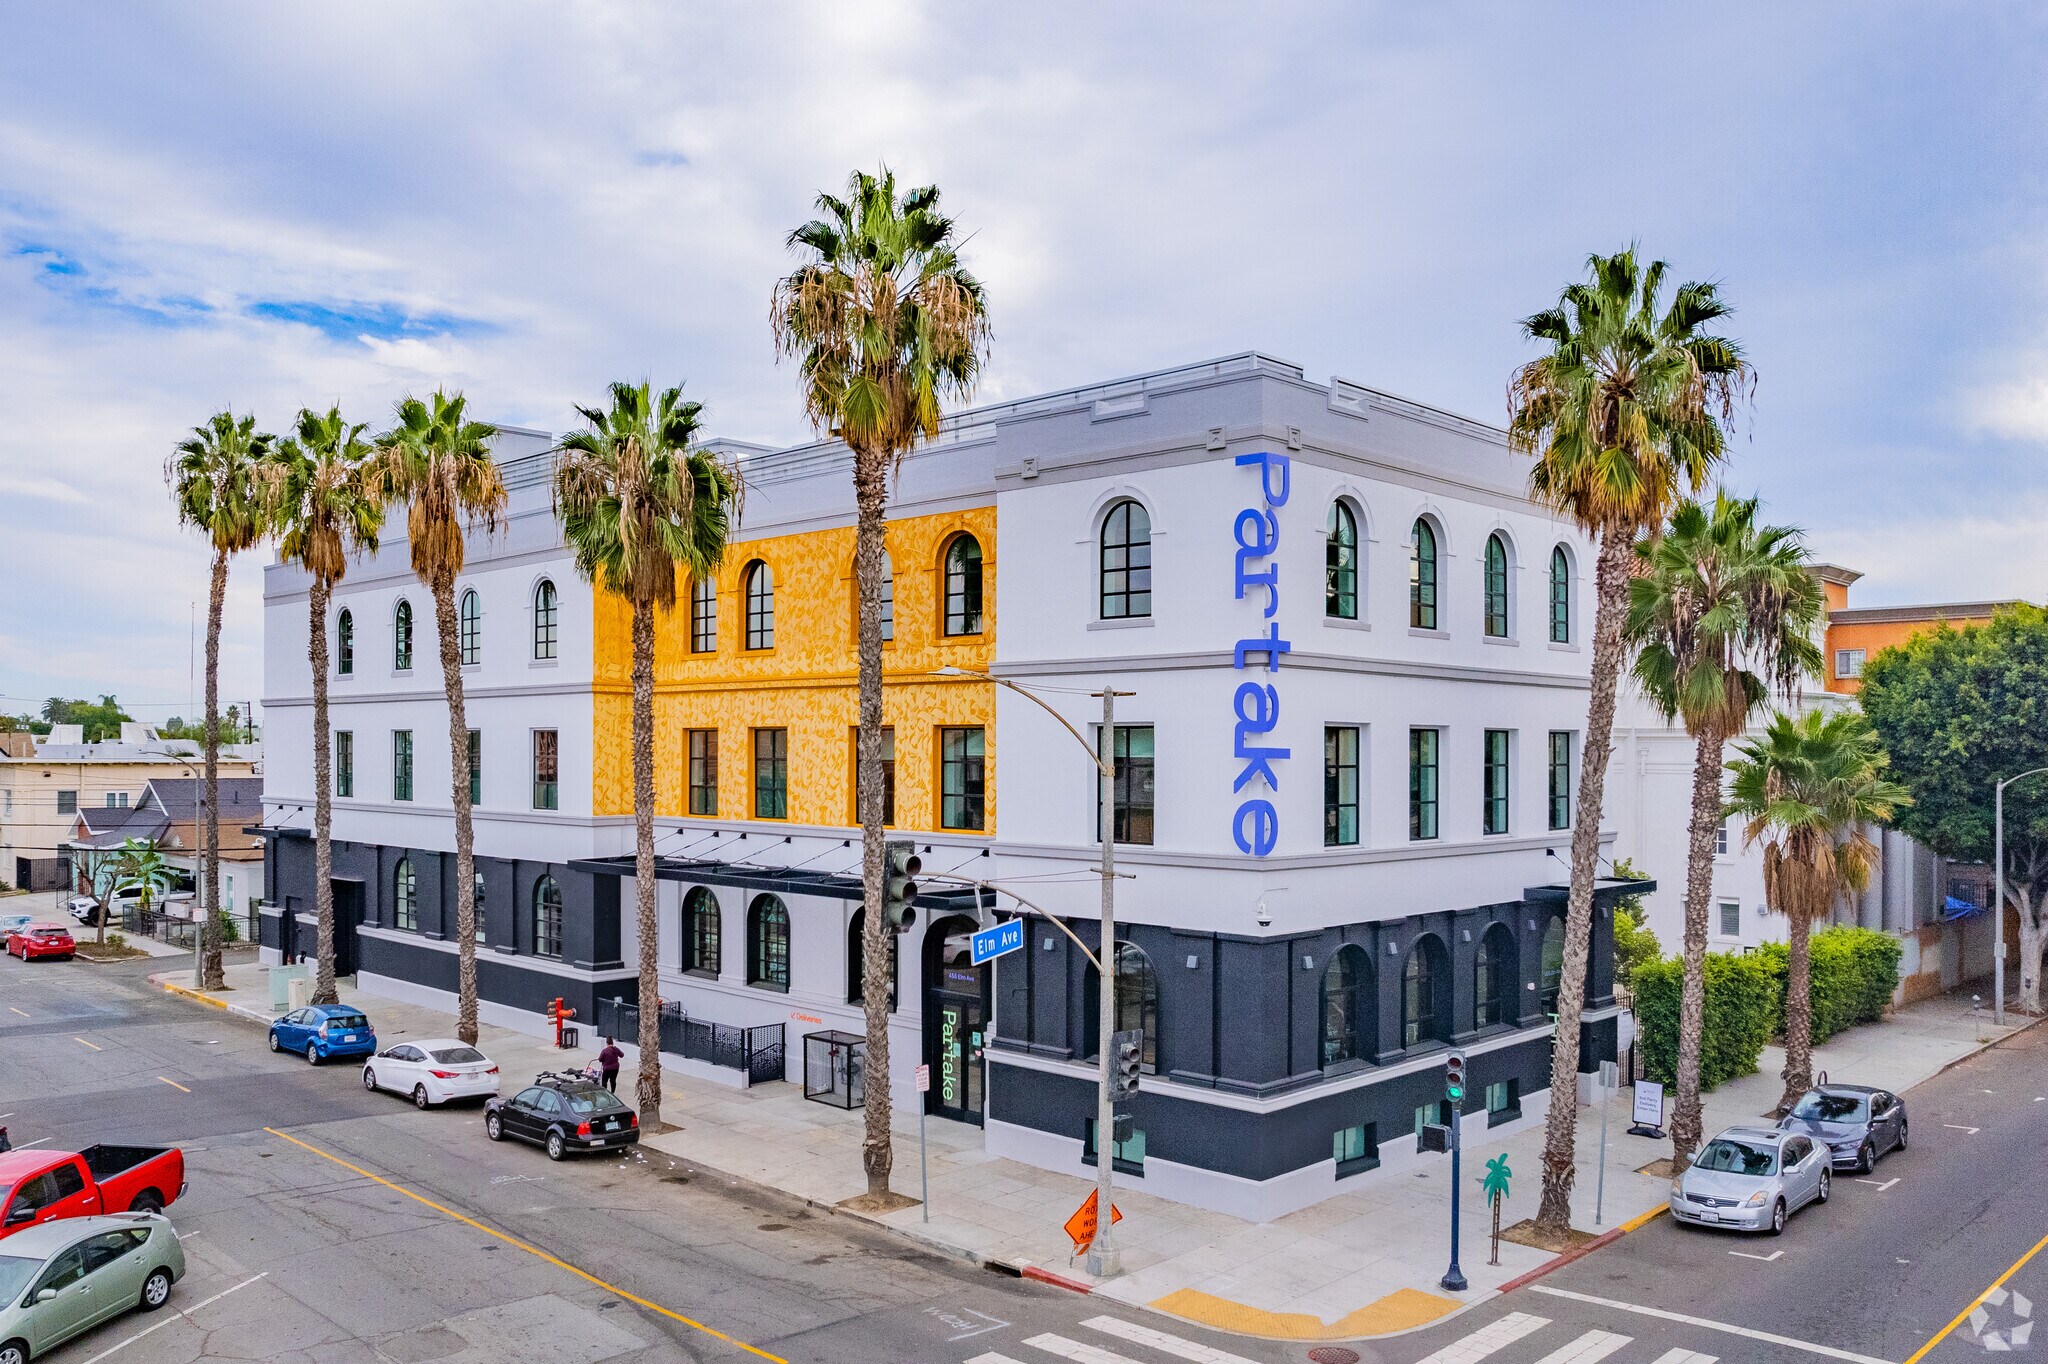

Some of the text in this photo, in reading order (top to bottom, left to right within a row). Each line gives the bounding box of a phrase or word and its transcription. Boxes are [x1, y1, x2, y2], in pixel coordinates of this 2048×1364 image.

[1233, 452, 1291, 857] Partake
[978, 930, 1018, 956] Elm Ave
[796, 1012, 822, 1025] Deliveries
[942, 1010, 957, 1101] Partake
[1084, 1205, 1098, 1216] RO
[1079, 1229, 1095, 1241] AHE
